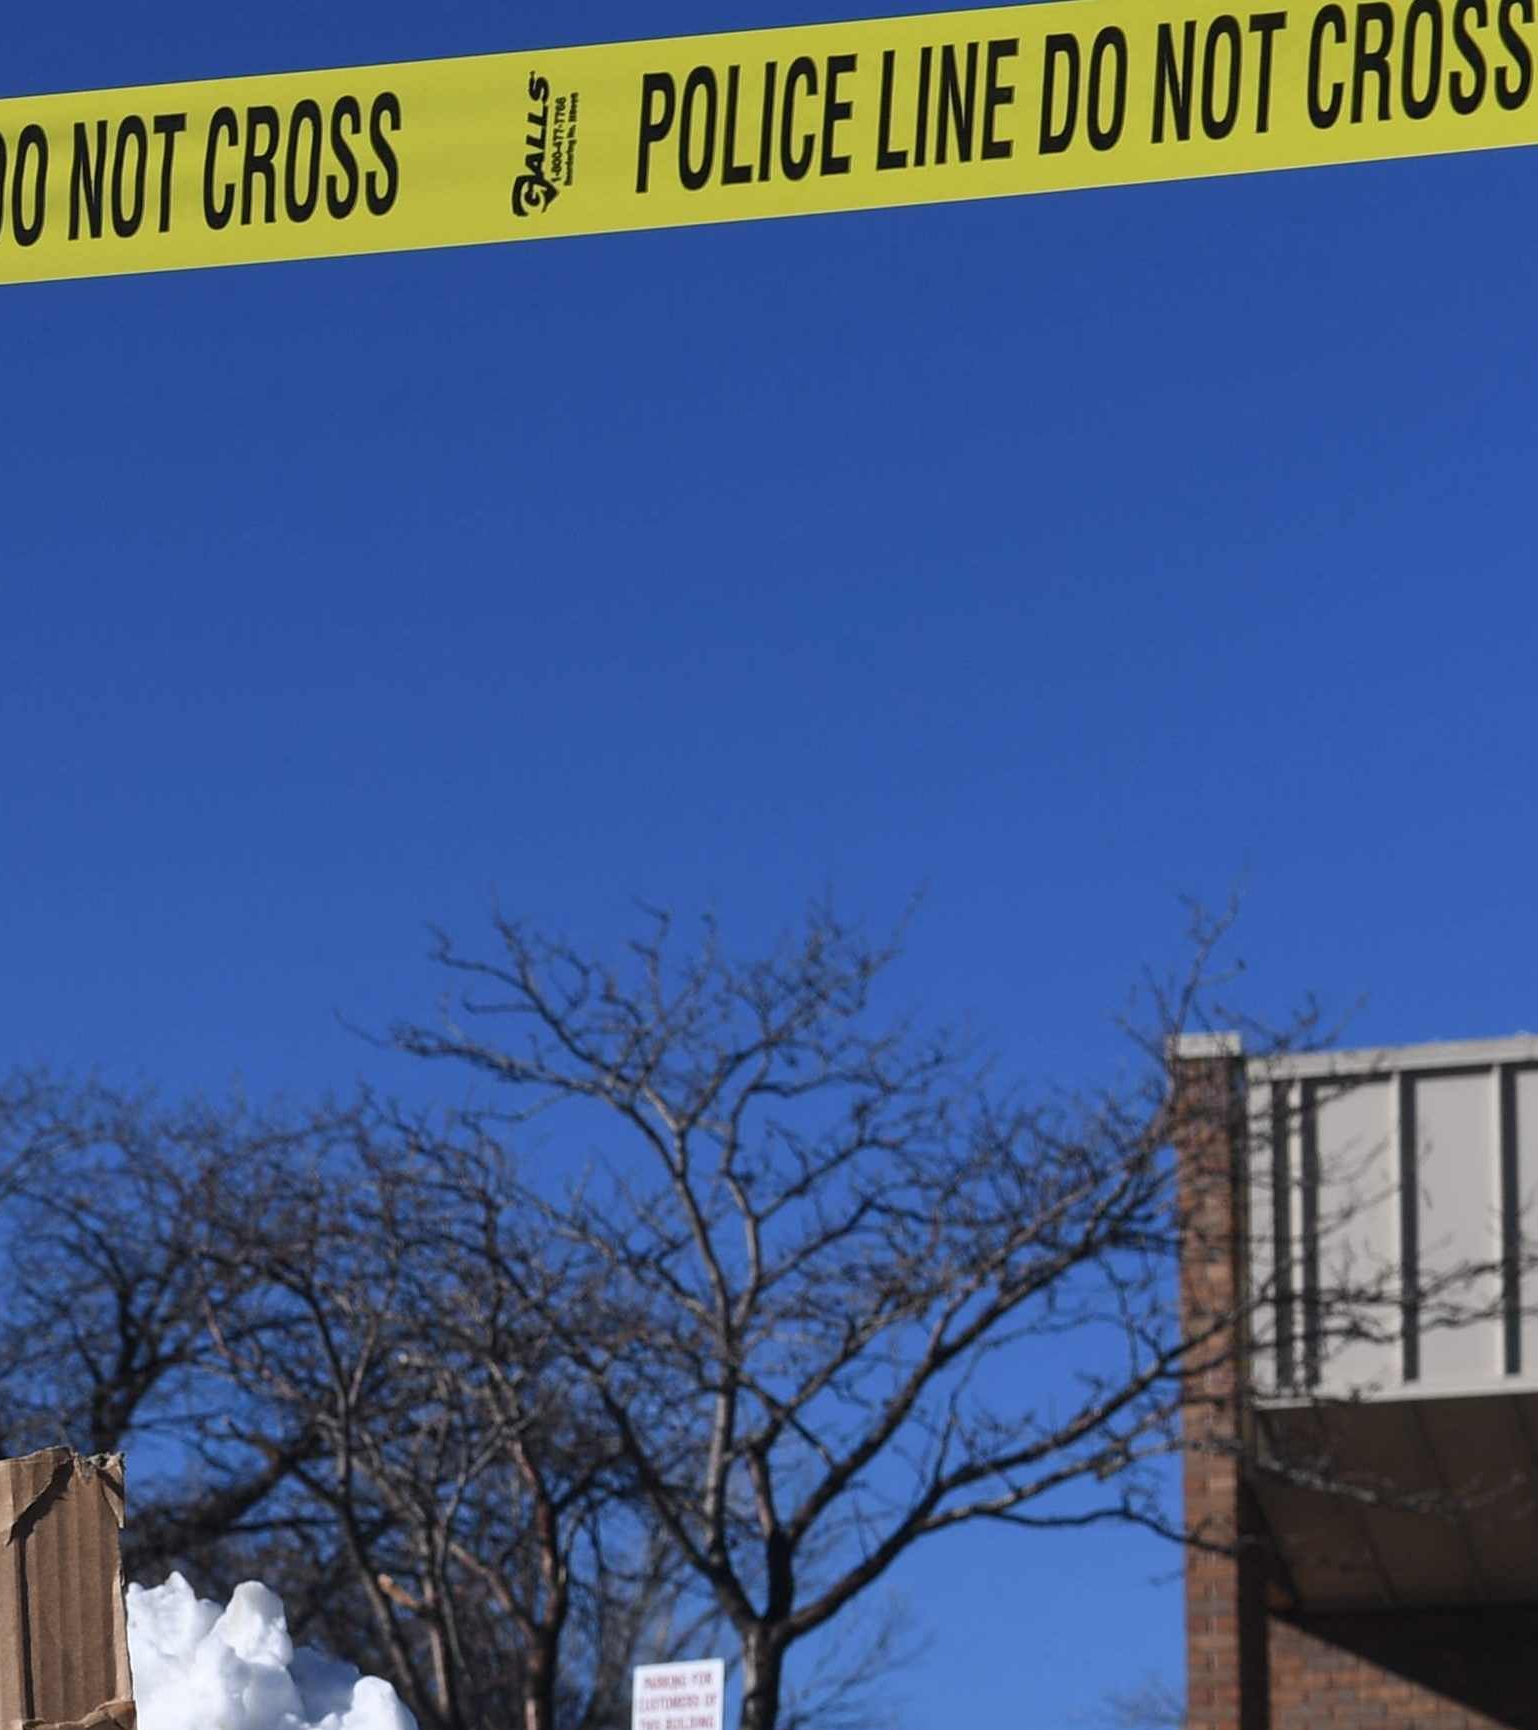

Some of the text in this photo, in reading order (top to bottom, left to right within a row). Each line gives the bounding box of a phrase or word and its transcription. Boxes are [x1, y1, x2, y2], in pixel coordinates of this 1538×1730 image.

[67, 113, 186, 242] NOT
[203, 91, 401, 230] CROSS
[512, 71, 559, 217] GALLS
[636, 0, 1535, 193] POLICE LINE DO NOT CROSS
